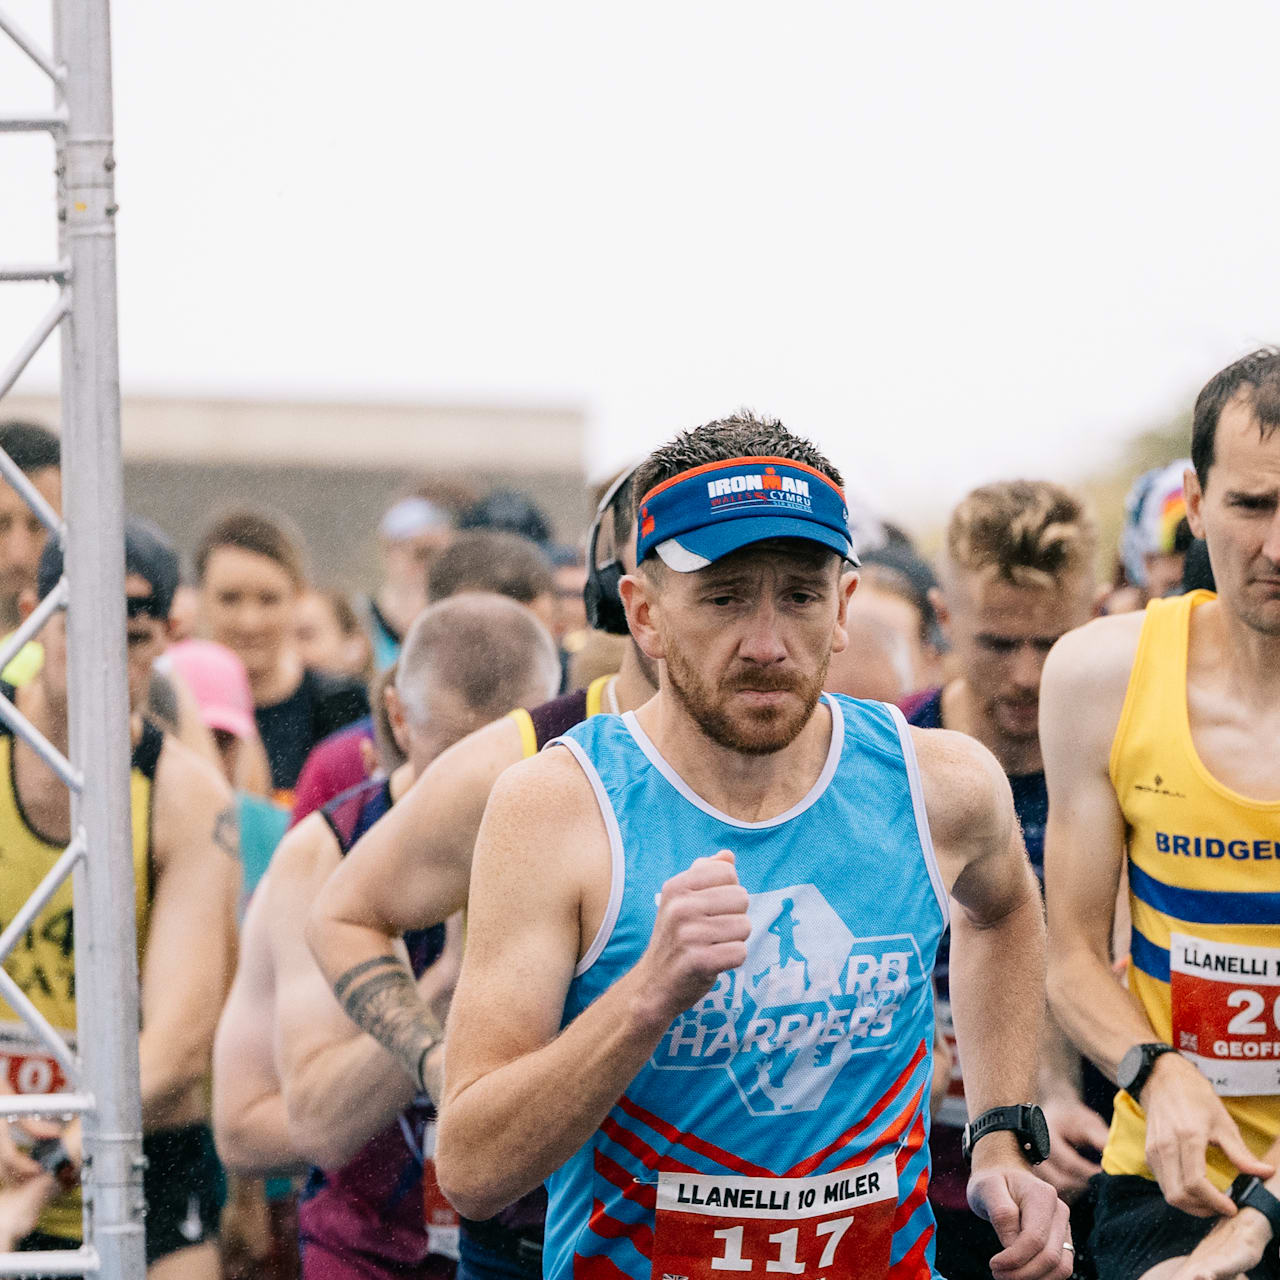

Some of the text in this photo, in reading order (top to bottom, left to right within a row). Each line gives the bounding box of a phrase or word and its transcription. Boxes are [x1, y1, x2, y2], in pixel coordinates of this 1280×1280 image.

[707, 472, 809, 499] IRONMAN
[710, 492, 752, 506] WALES
[769, 491, 811, 507] CYMRU
[1184, 948, 1268, 976] LLANELLI
[677, 1171, 881, 1211] LLANELLI 10 MILER
[711, 1215, 855, 1275] 117
